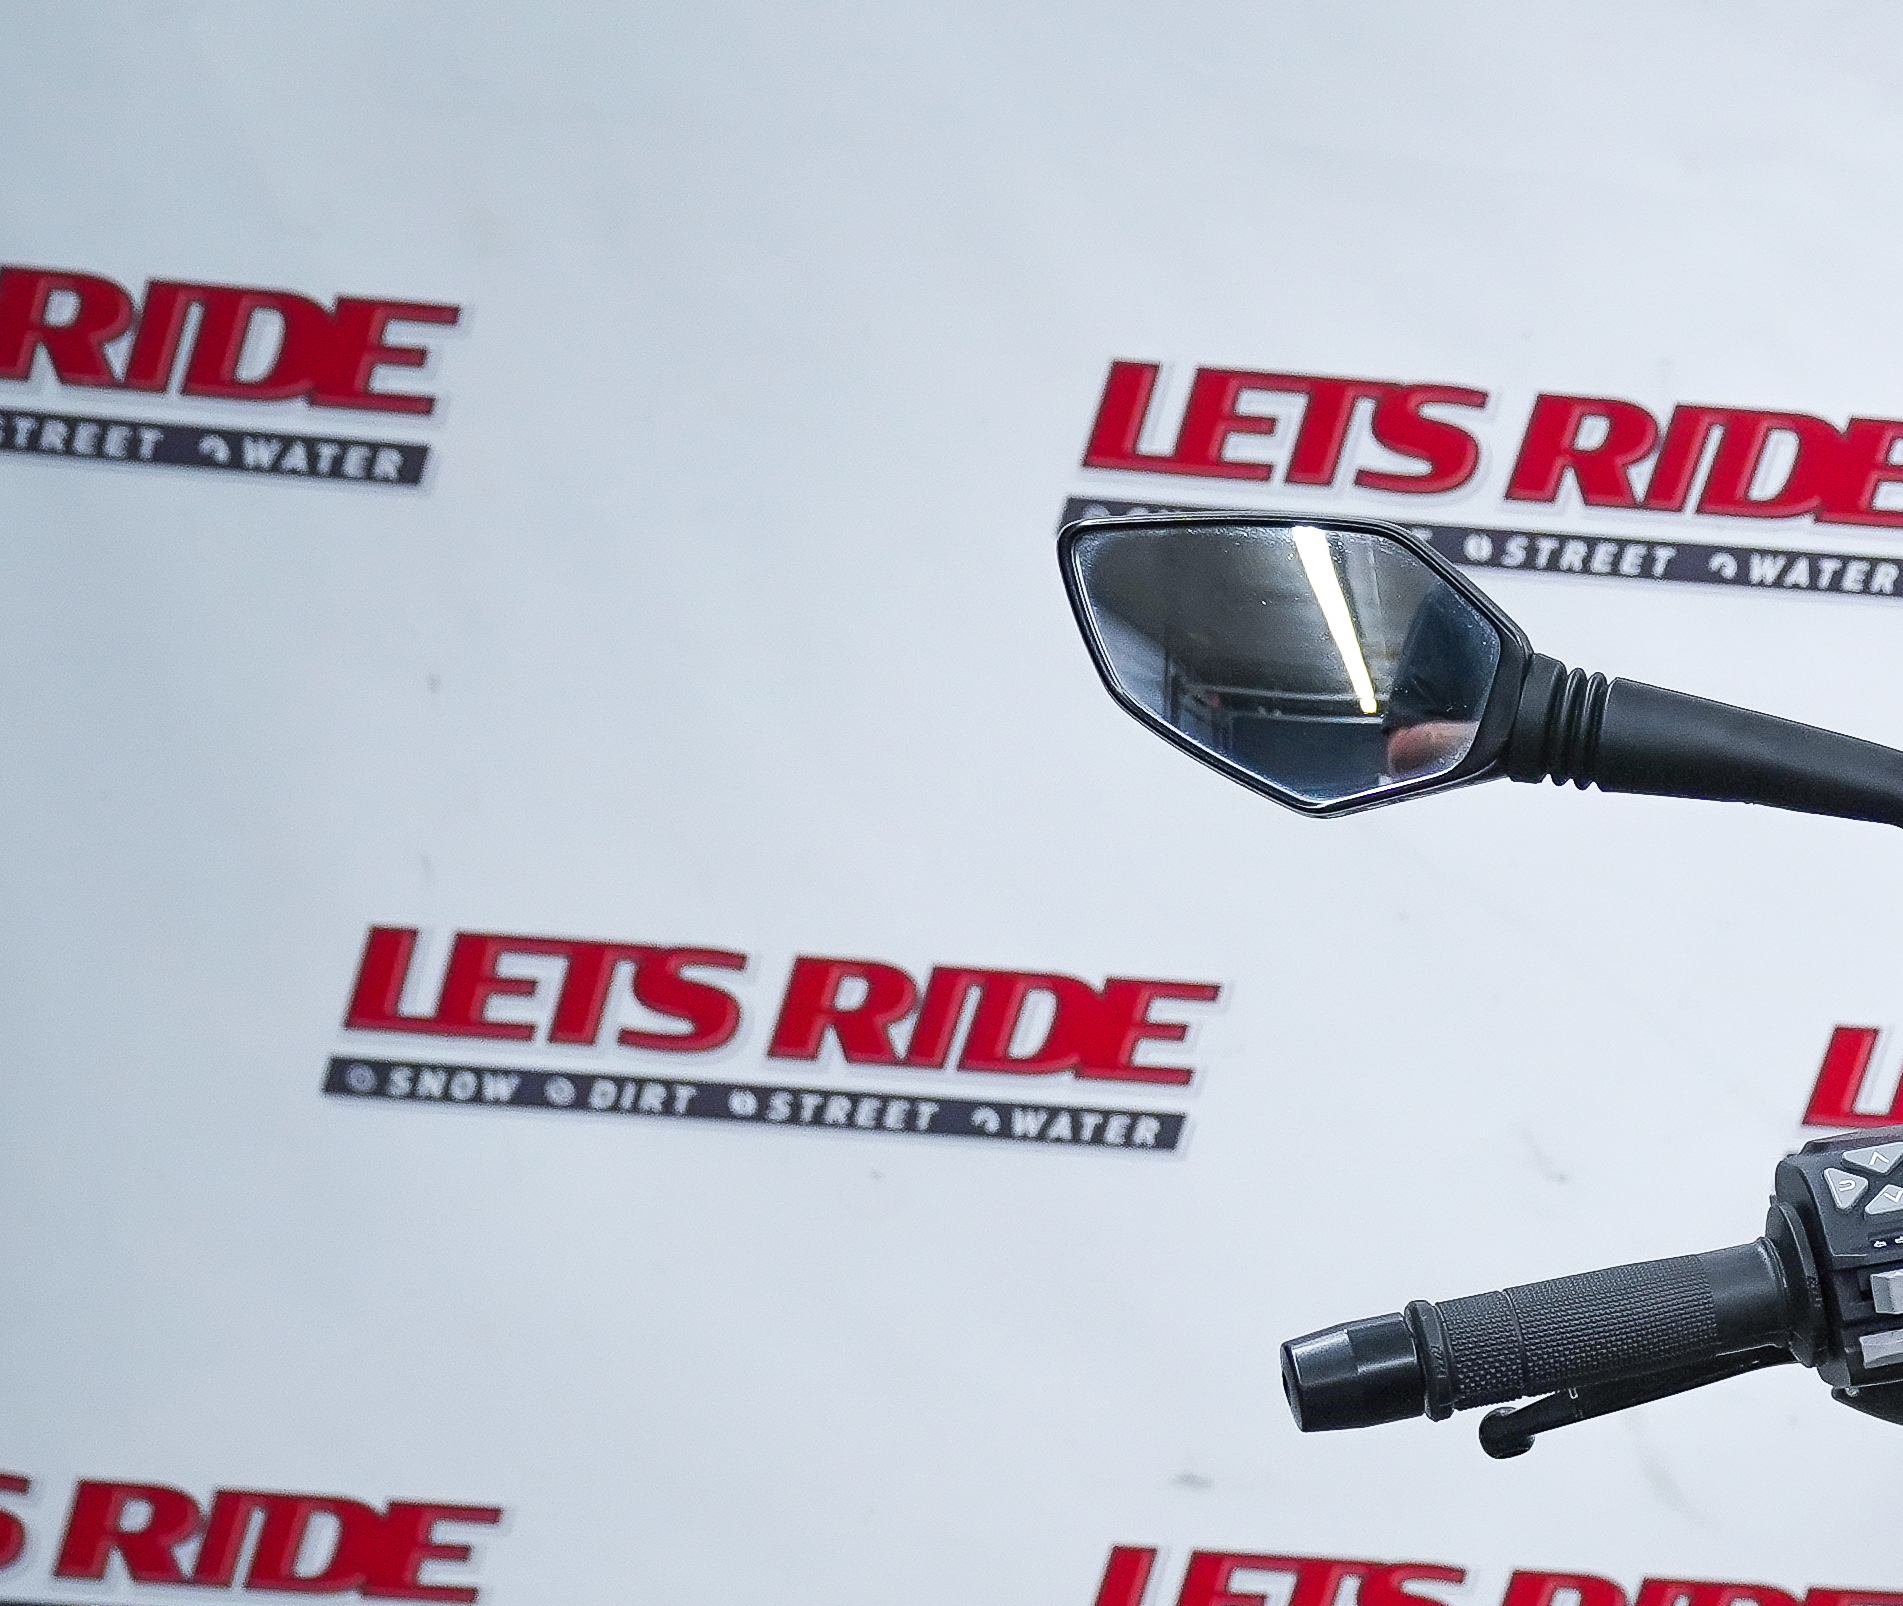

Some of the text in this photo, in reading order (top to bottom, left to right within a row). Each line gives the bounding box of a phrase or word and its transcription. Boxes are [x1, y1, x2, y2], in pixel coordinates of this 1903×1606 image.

[0, 265, 459, 415] RIDE
[0, 414, 404, 482] TREET WATER
[1082, 359, 1485, 496] LETS
[1500, 534, 1901, 594] STREET WATER
[344, 925, 1219, 1086] LETS RIDE
[386, 1066, 1162, 1146] SNOW DIRT STREET WATER
[55, 1479, 503, 1604] RIDE
